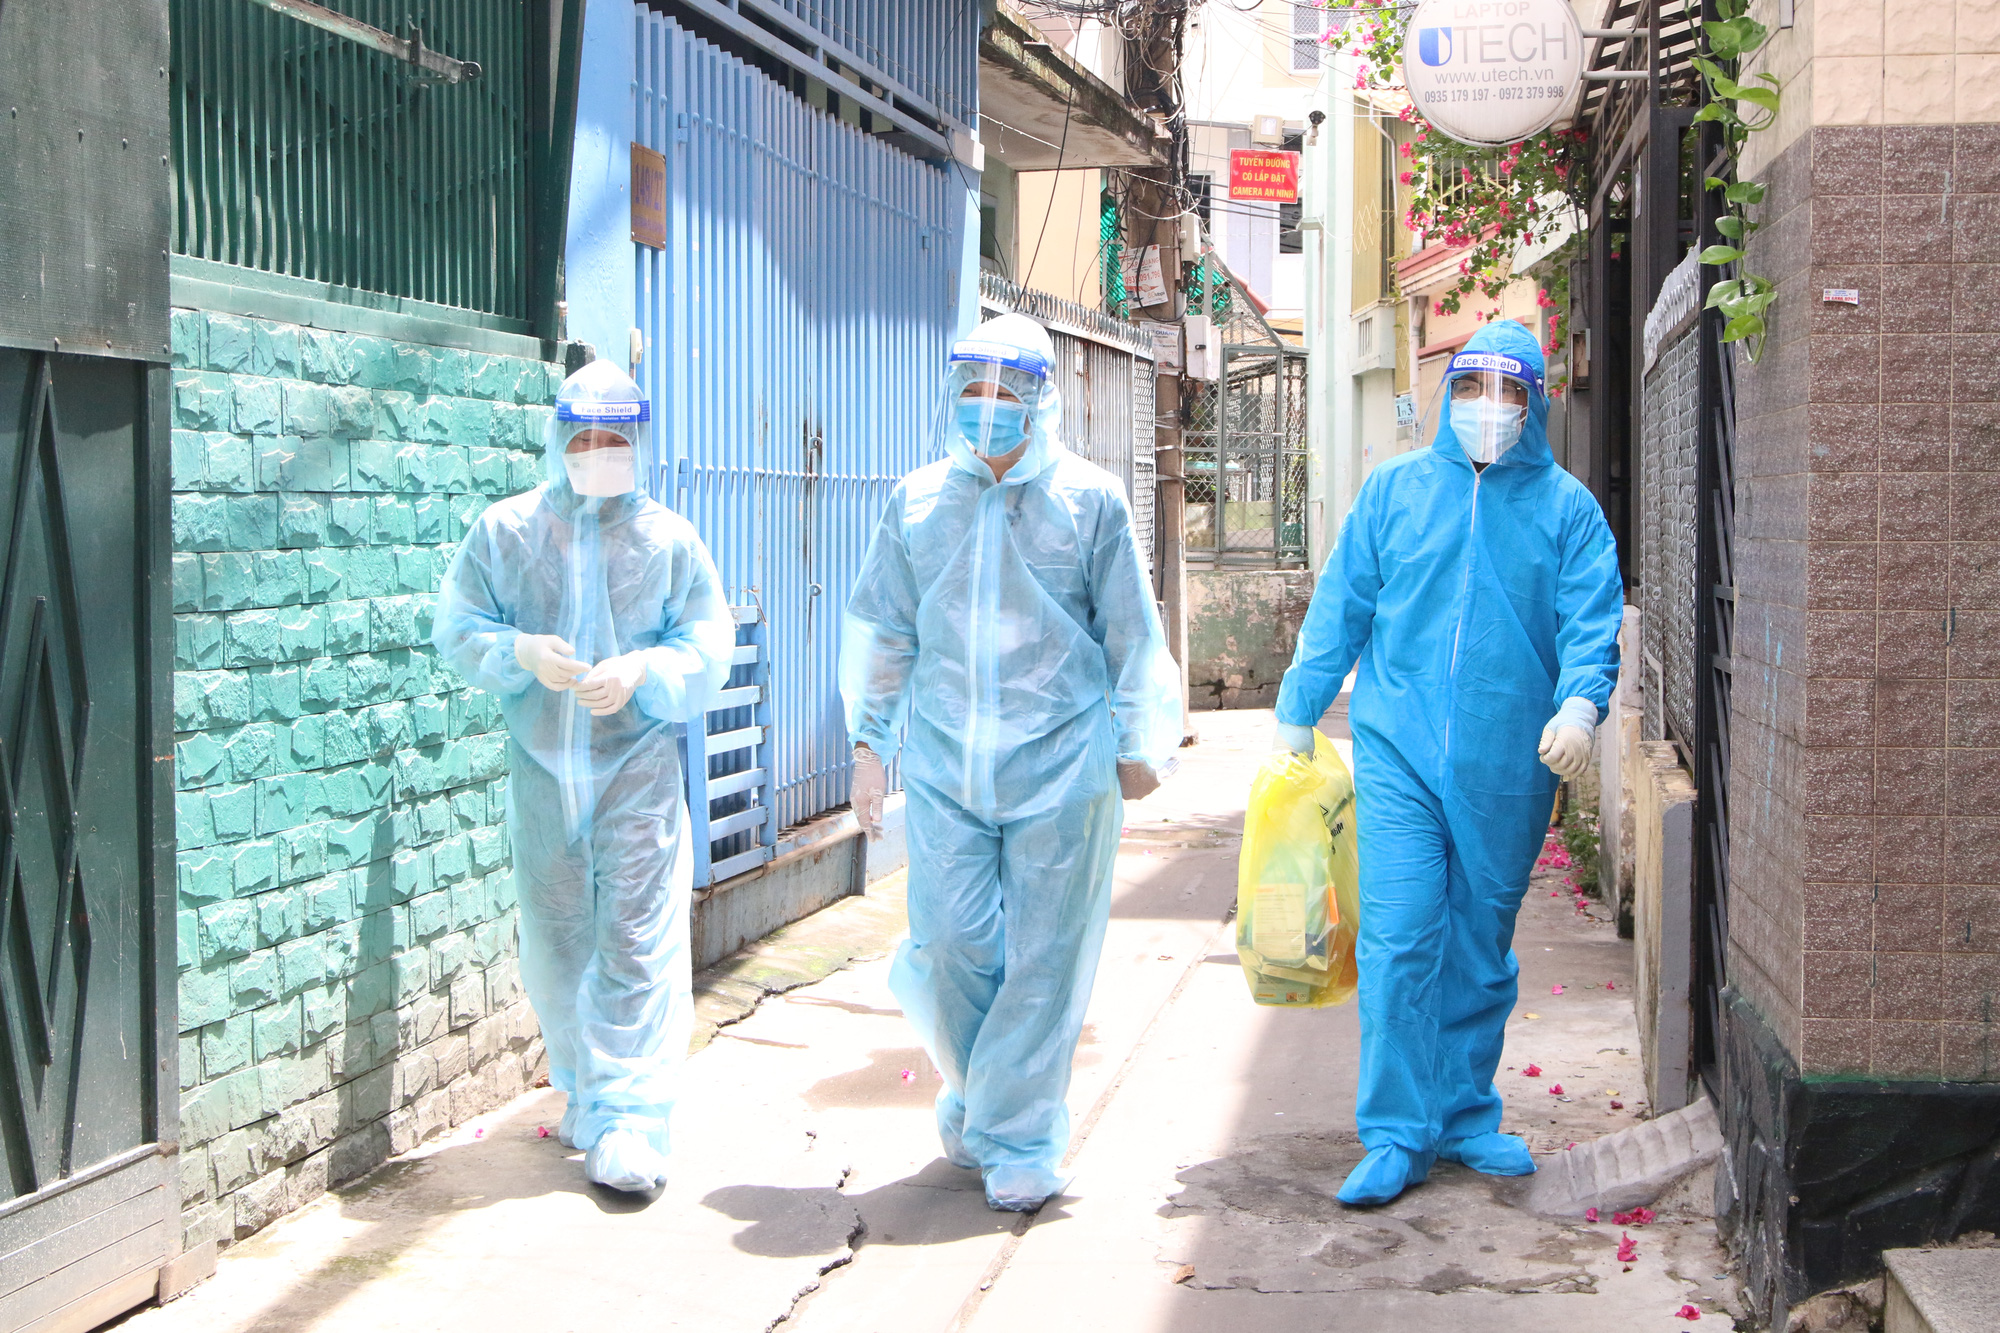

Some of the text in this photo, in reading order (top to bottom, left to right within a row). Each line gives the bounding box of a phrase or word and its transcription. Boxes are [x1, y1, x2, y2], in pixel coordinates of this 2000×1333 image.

[1453, 2, 1530, 20] LAPTOP
[1434, 67, 1554, 85] www.utech.vn
[1424, 89, 1447, 103] 0935
[1451, 88, 1469, 102] 179
[1472, 88, 1489, 102] 197
[1499, 87, 1523, 101] 0972
[1526, 86, 1544, 99] 379
[1547, 85, 1564, 99] 998
[1242, 170, 1252, 181] CÓ
[635, 162, 663, 212] 149/27
[1232, 187, 1294, 199] CAMERA AN NINH
[1456, 357, 1478, 366] Face
[1482, 356, 1517, 371] Shield
